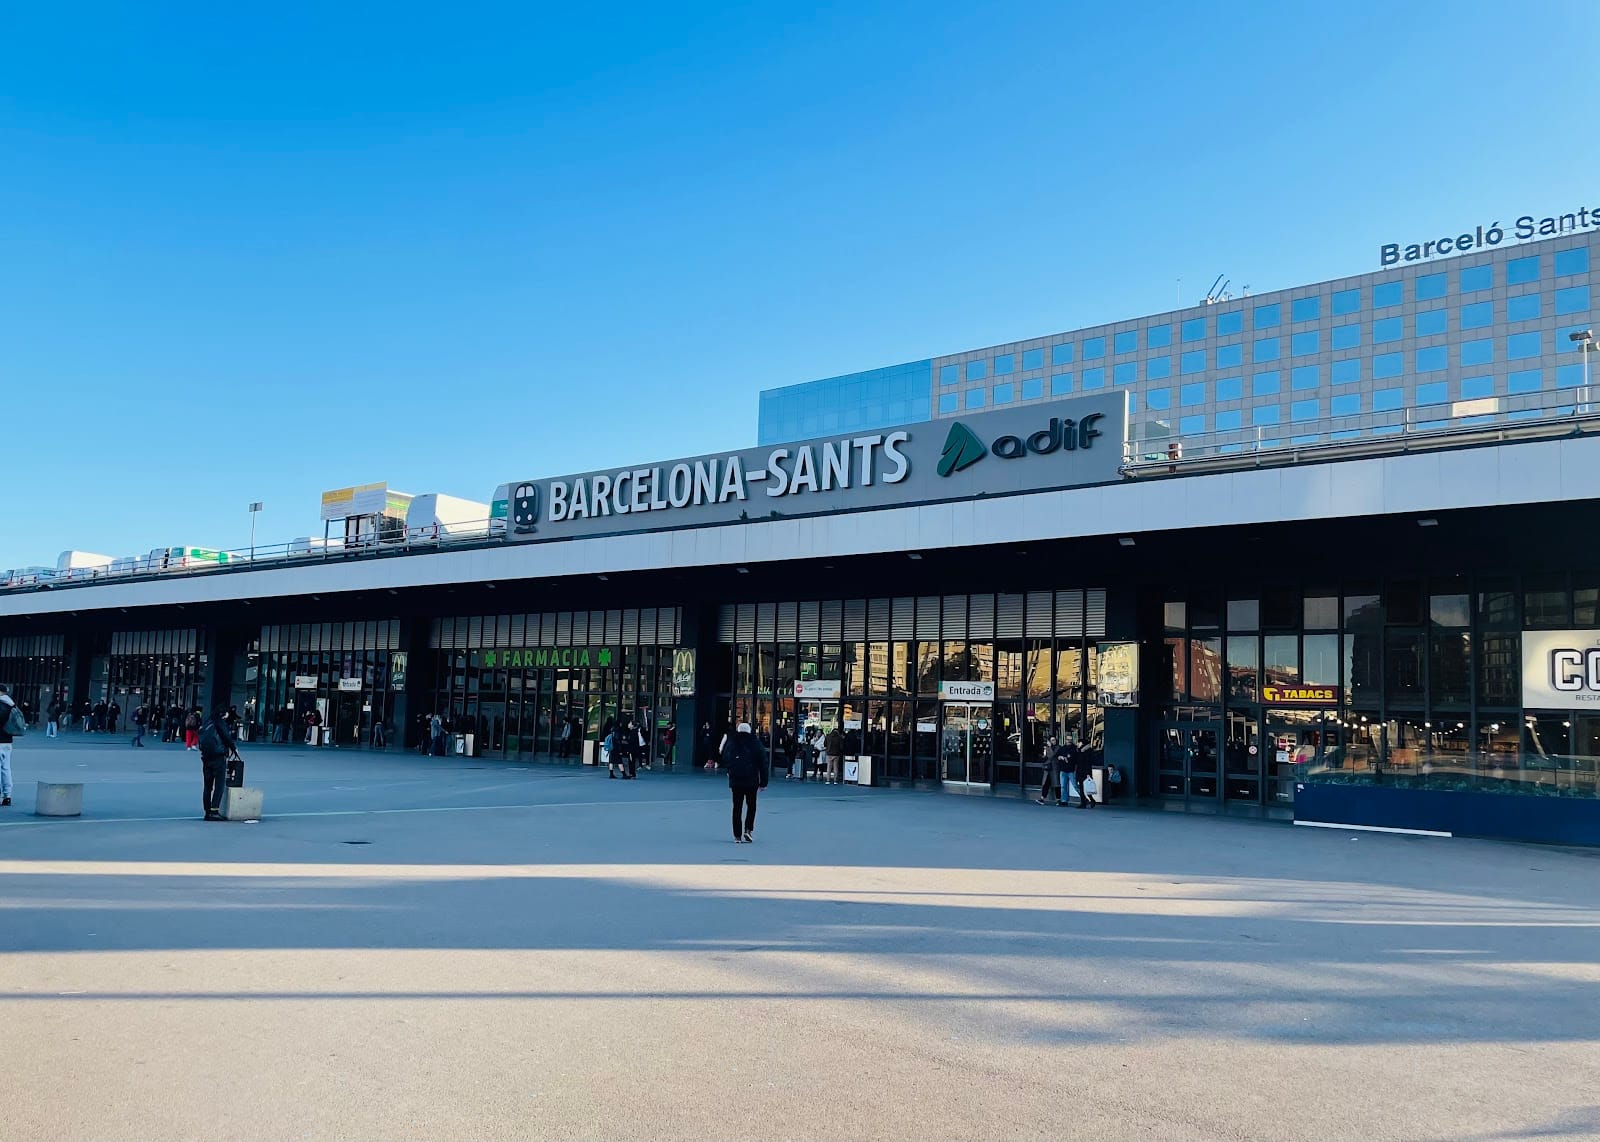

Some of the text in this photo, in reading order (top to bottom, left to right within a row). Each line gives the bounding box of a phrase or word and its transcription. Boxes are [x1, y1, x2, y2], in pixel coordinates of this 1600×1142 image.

[1380, 206, 1600, 266] Barceló Sants
[991, 412, 1105, 459] adif
[549, 431, 911, 522] BARCELONA-SANTS
[502, 645, 590, 667] FARMÀCIA
[949, 686, 981, 695] Entrada
[1282, 689, 1334, 699] TABACS
